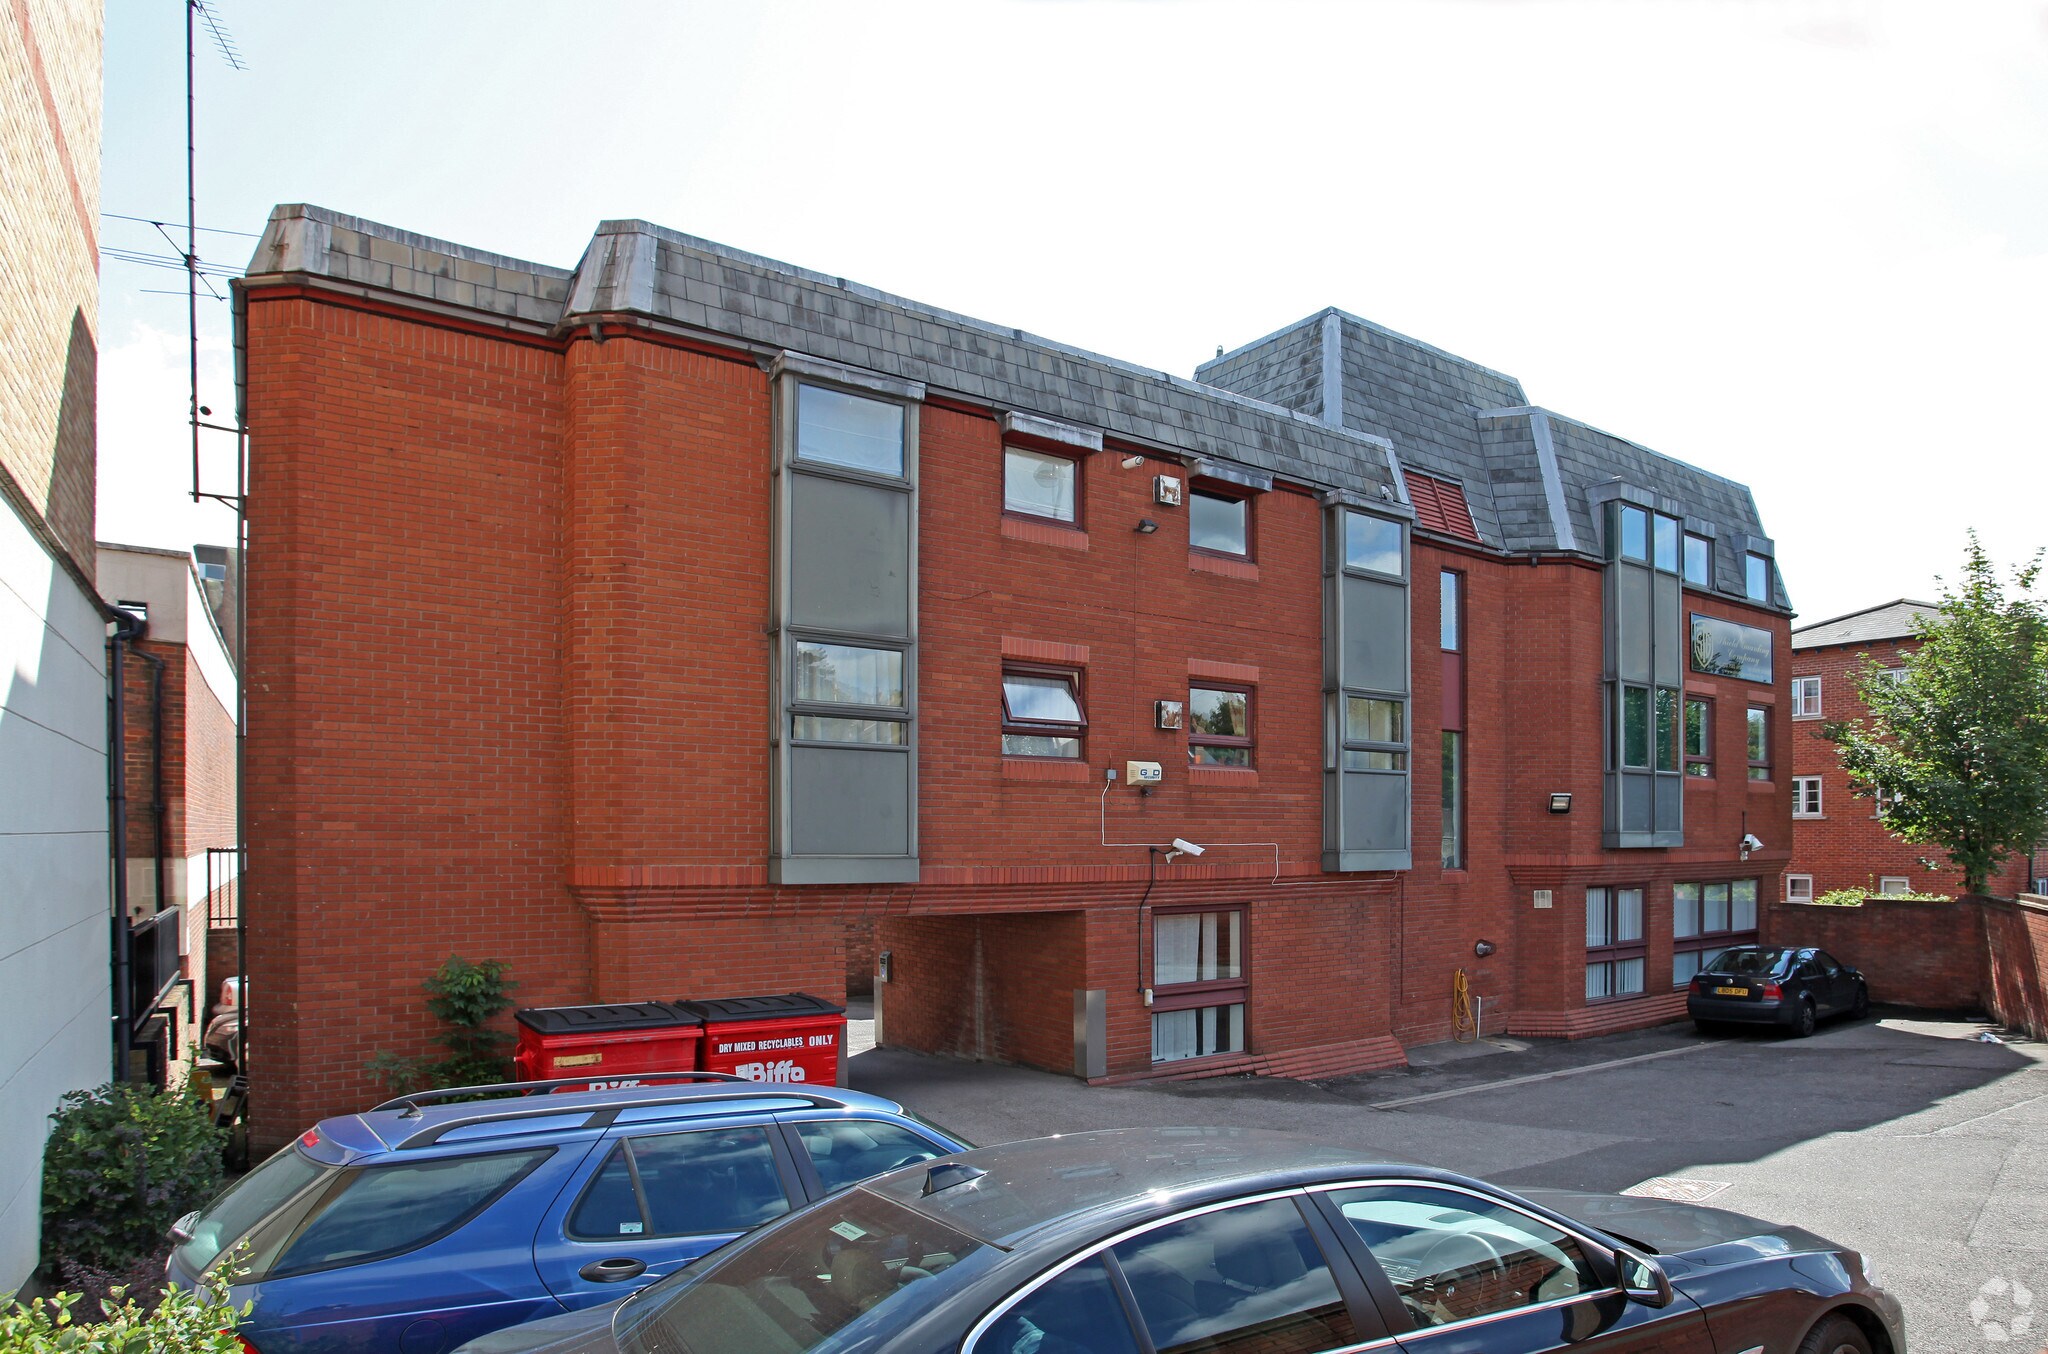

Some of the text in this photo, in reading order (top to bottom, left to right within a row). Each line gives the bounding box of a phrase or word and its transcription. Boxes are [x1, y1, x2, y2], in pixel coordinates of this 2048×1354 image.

[719, 1034, 834, 1054] DRY MIXED RECYCLABLES ONLY
[749, 1060, 805, 1083] Biffa
